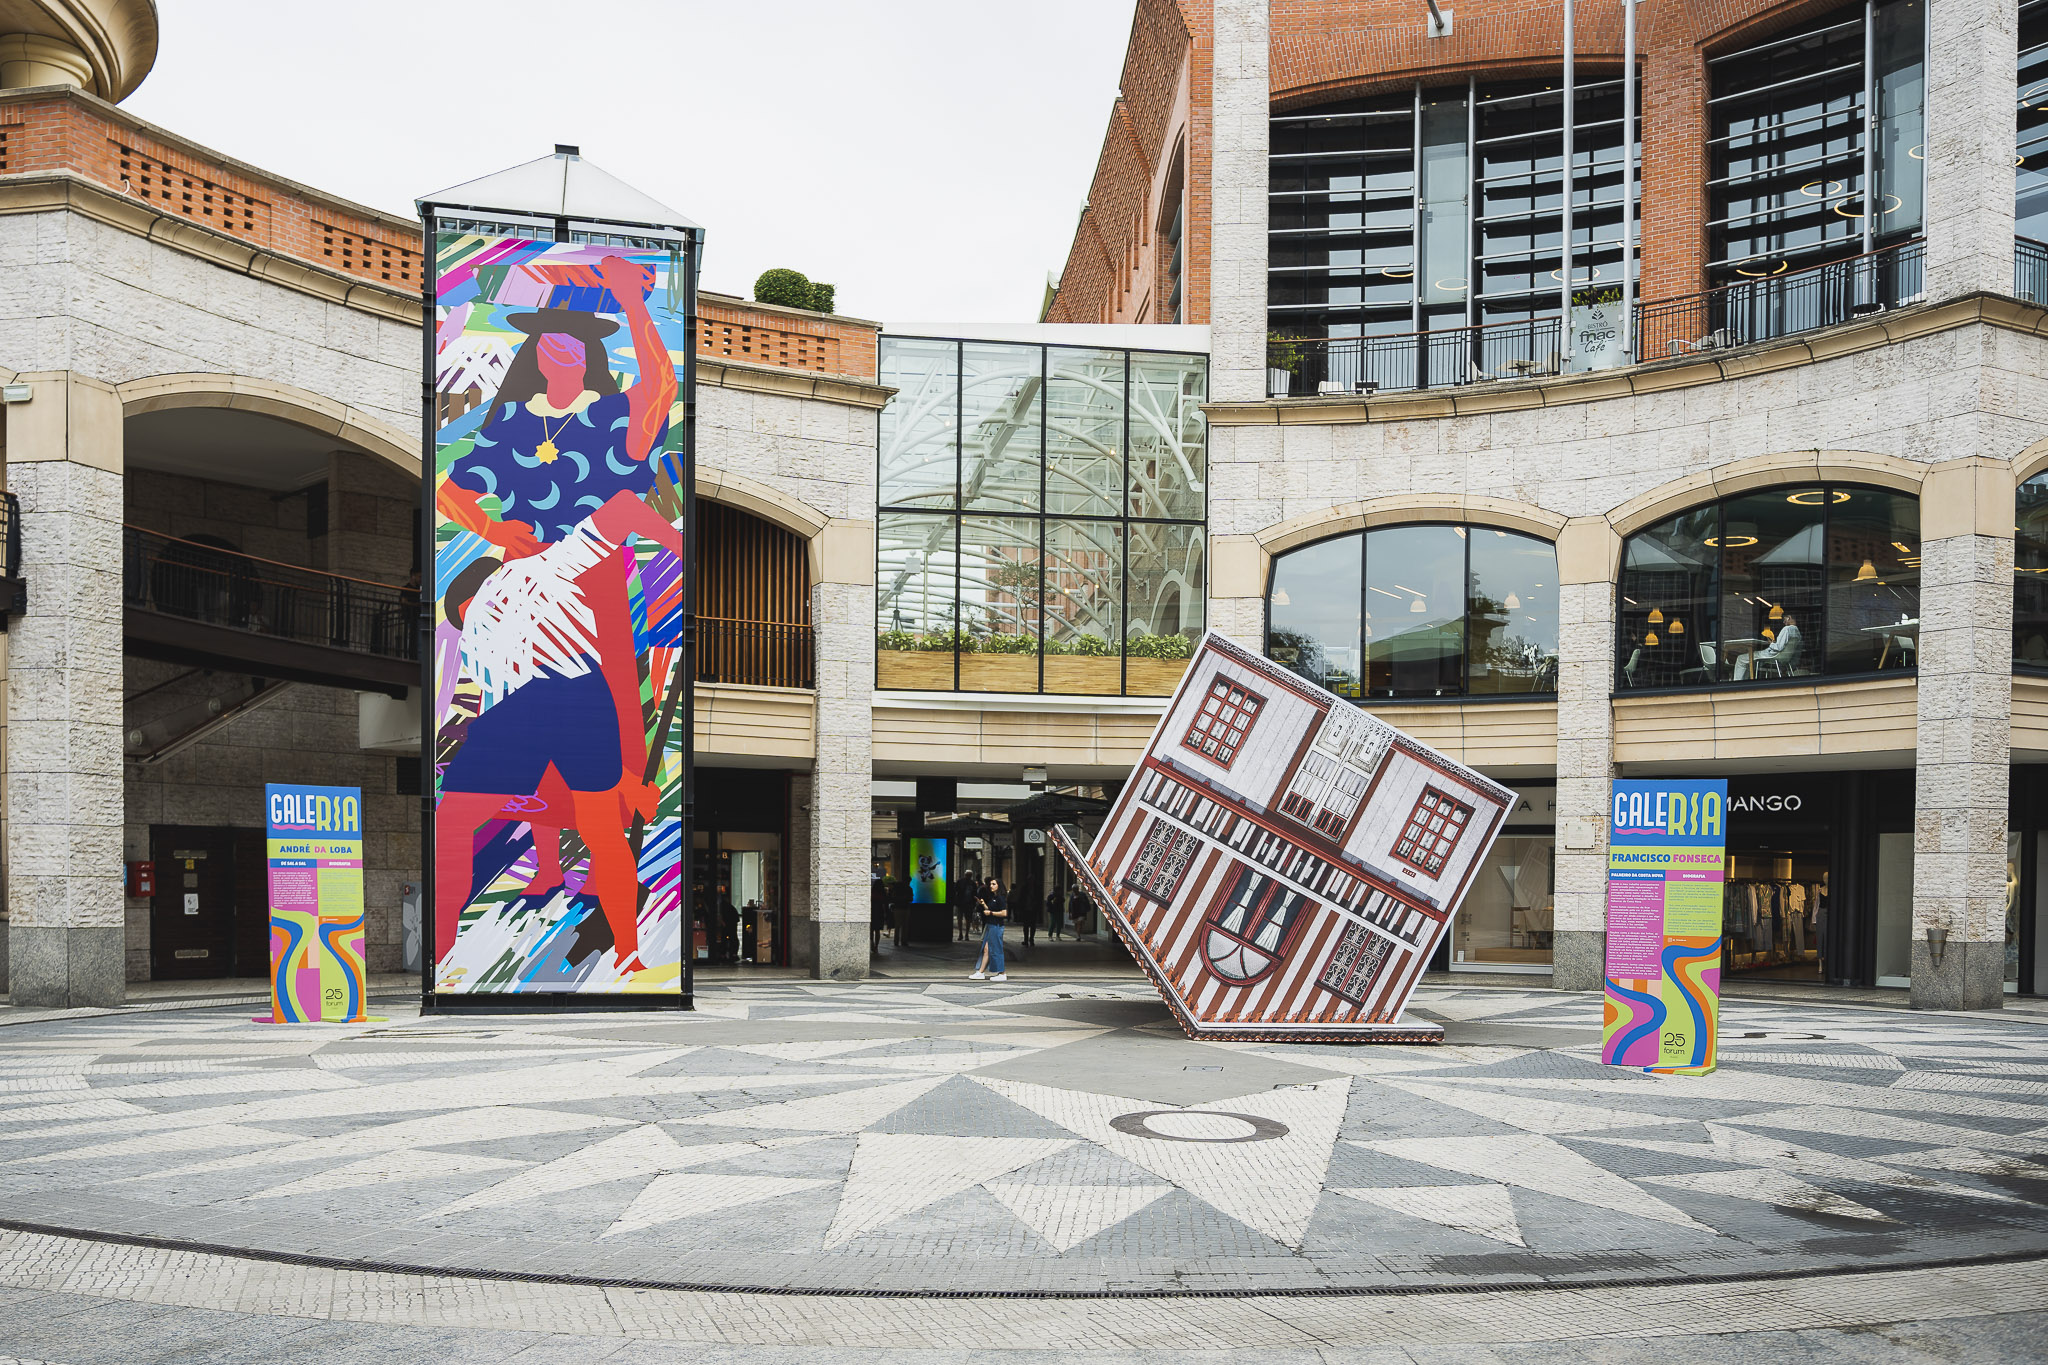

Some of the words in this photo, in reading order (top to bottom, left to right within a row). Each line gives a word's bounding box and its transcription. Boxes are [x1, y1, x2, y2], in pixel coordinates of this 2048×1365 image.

[1579, 330, 1616, 343] fnac
[270, 793, 359, 832] GALERIA
[1614, 791, 1722, 836] GALERIA
[280, 844, 311, 854] ANDRÉ
[314, 846, 326, 854] DA
[330, 846, 352, 854] LOBA
[1612, 853, 1671, 863] FRANCISCO
[1672, 854, 1722, 864] FONSECA
[326, 989, 343, 999] 25
[1664, 1033, 1685, 1046] 25
